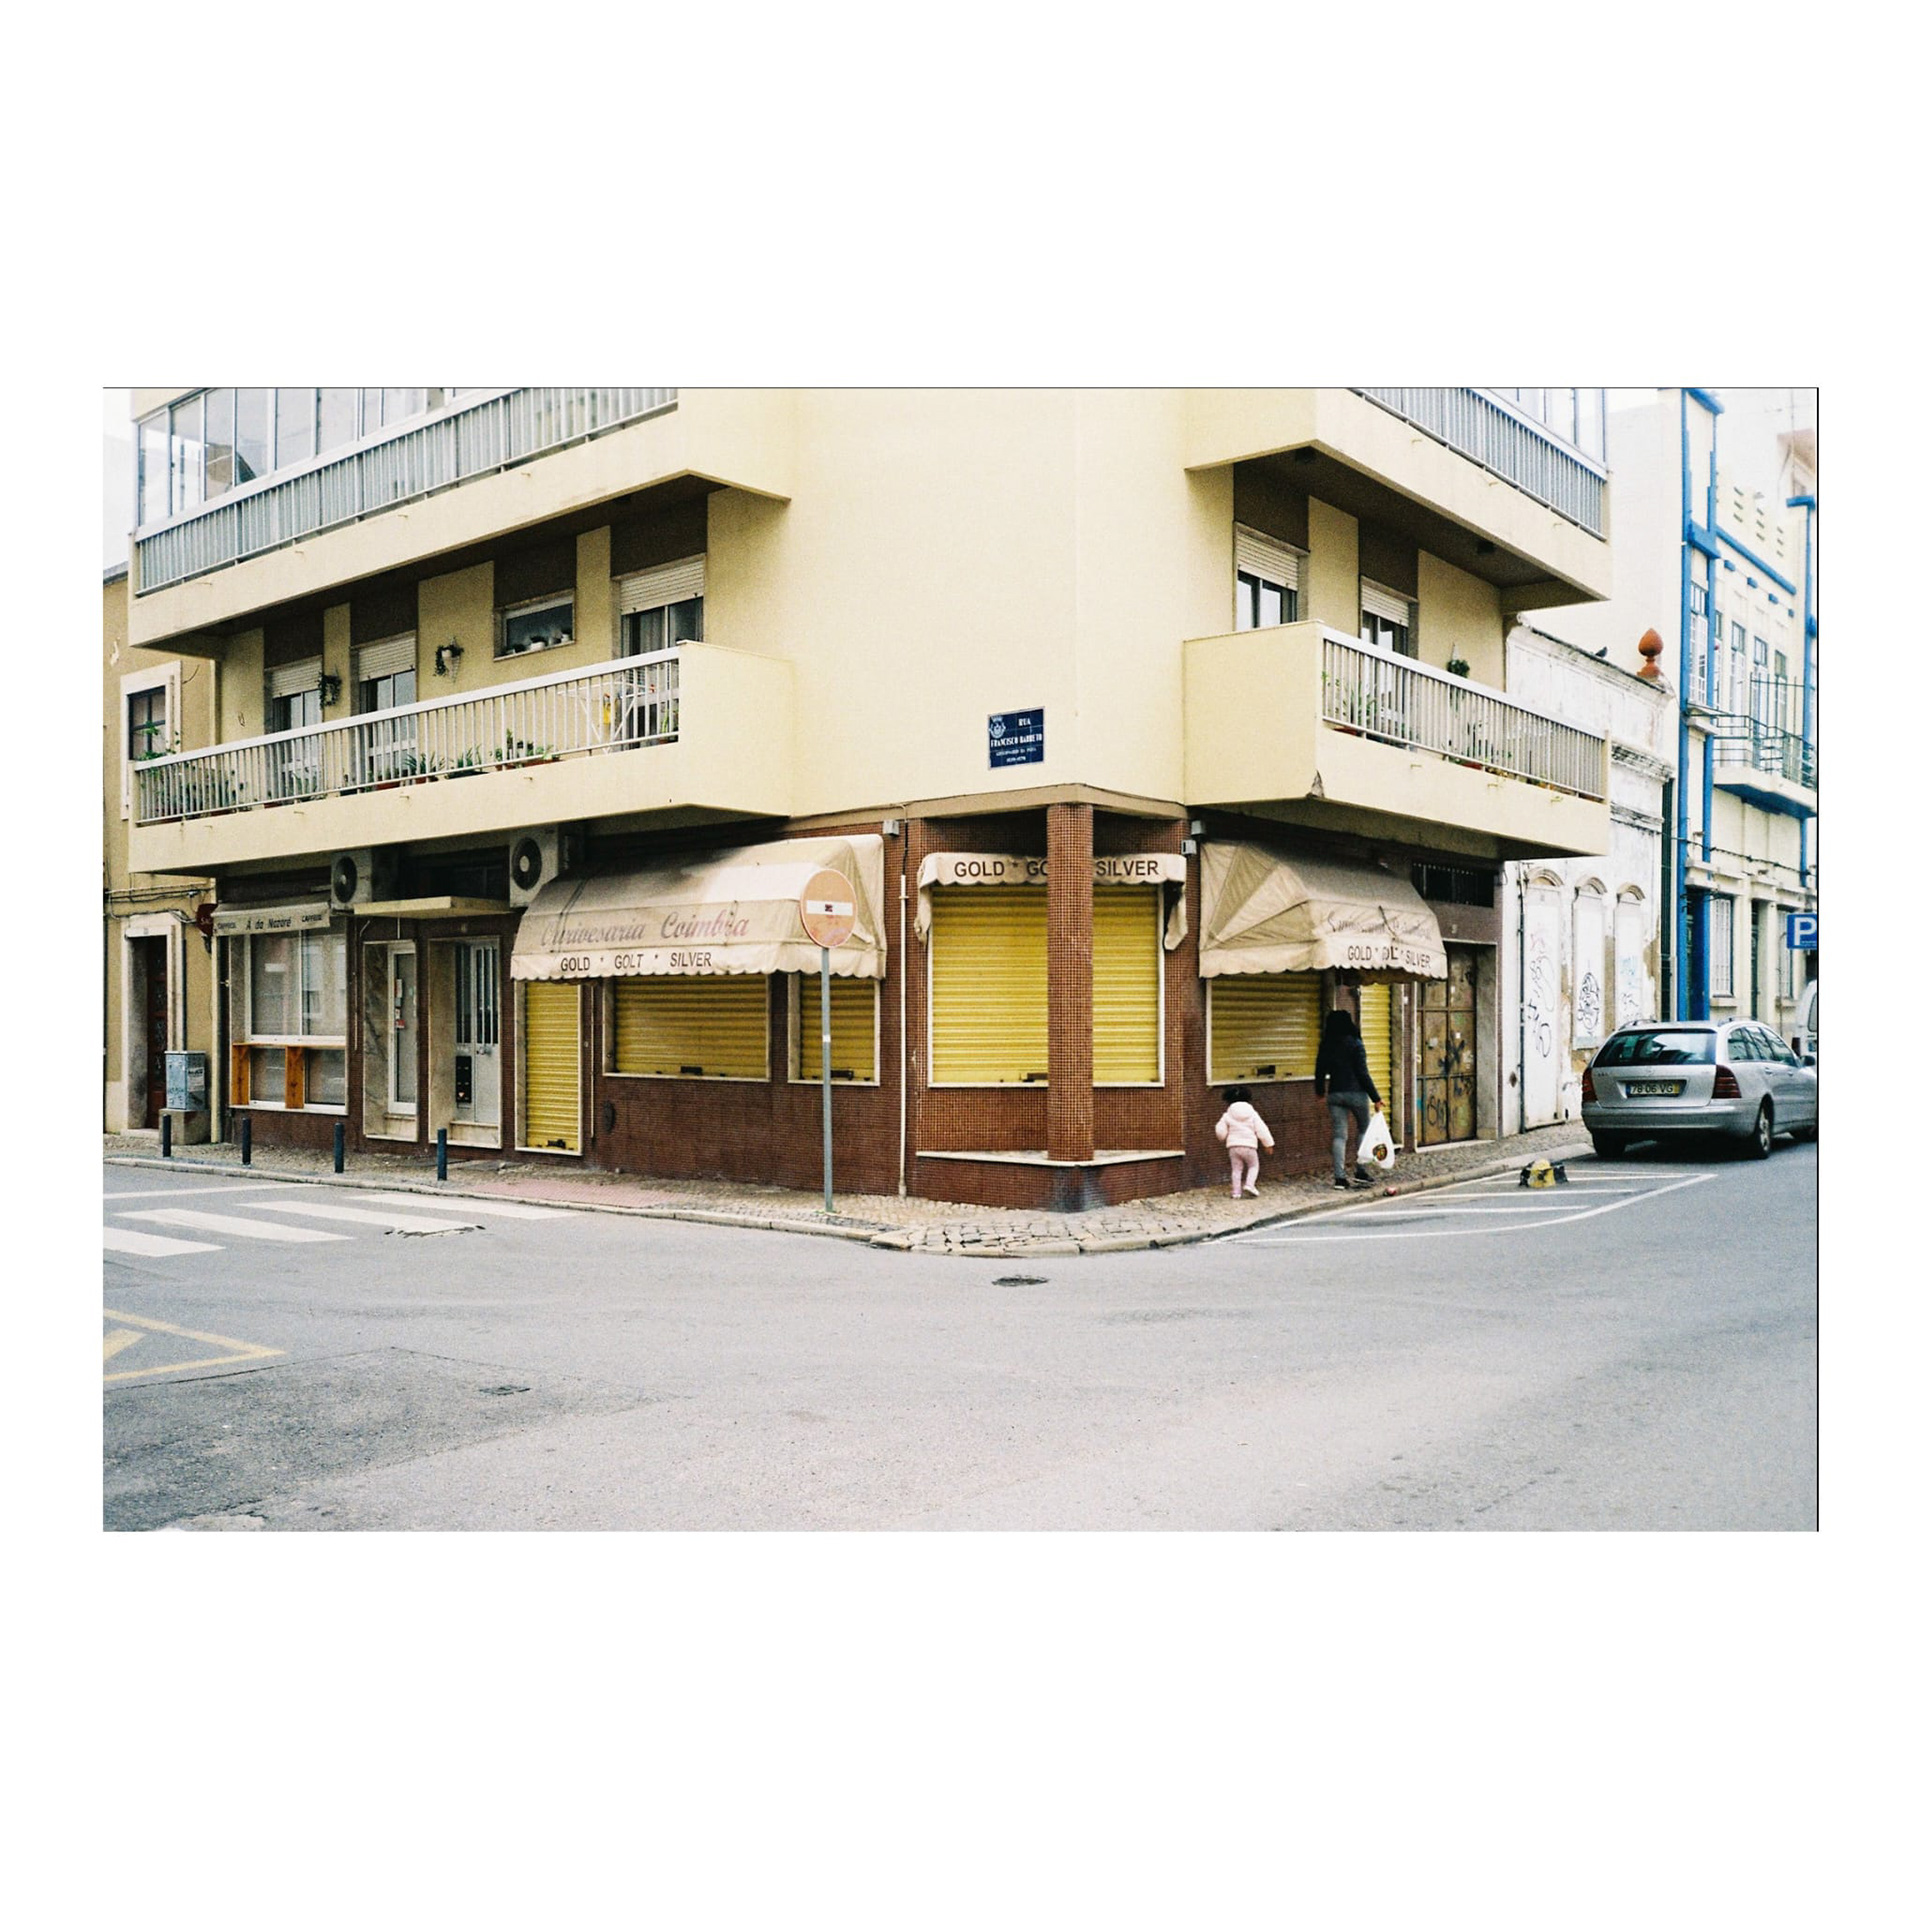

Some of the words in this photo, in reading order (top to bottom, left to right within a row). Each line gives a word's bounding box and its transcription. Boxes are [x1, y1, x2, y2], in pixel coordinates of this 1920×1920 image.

[1018, 718, 1031, 727] RUA
[990, 736, 1019, 748] FRANCISCO
[1019, 733, 1043, 744] BARRETO
[954, 860, 1005, 878] GOLD
[1095, 859, 1159, 877] SILVER
[660, 908, 750, 939] Coimbra
[1794, 917, 1817, 946] P
[560, 955, 591, 972] GOLD
[614, 953, 644, 970] GOLT
[670, 952, 712, 968] SILVER
[1347, 945, 1372, 961] GOLD
[1405, 950, 1431, 969] SILVER
